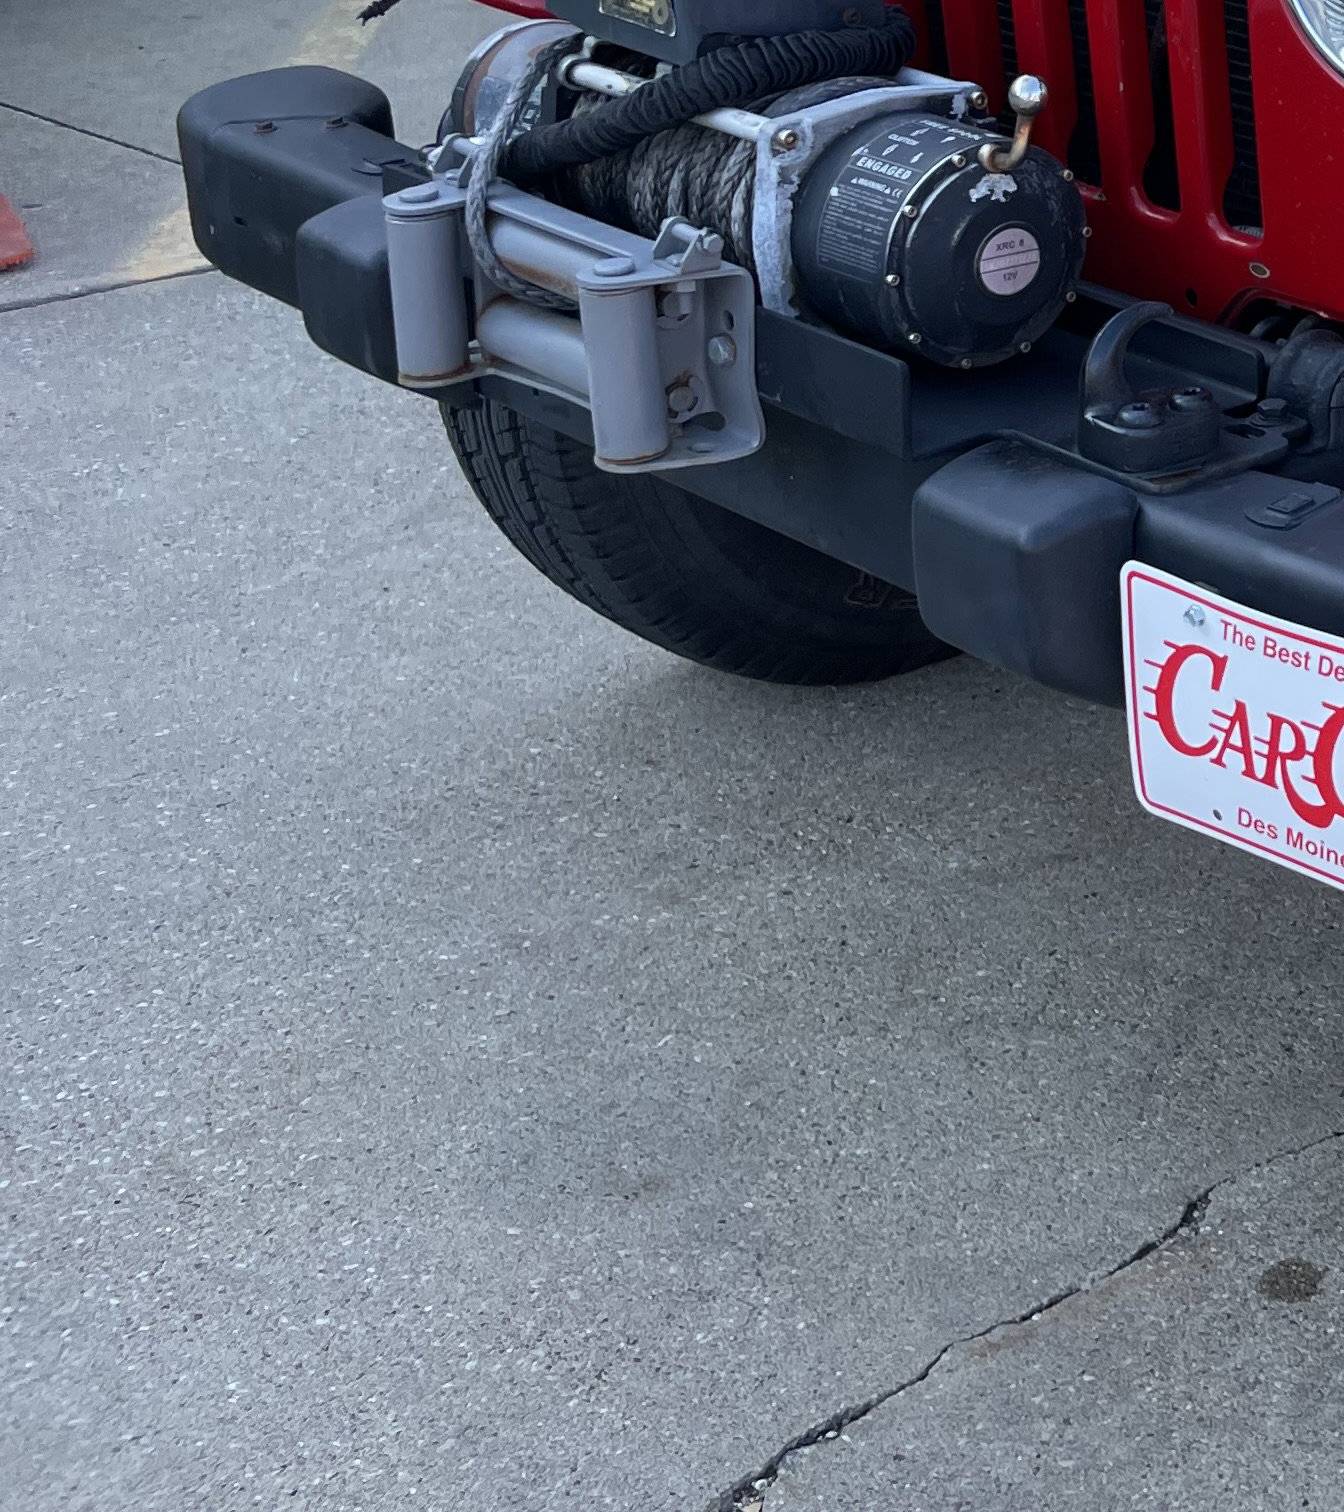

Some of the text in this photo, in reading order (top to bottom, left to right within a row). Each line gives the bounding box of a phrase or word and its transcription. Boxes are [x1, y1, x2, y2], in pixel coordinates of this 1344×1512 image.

[856, 156, 912, 179] ENGAGED
[996, 240, 1015, 251] XRC
[1003, 271, 1018, 281] 12V
[1220, 618, 1255, 651] The
[1263, 637, 1311, 670] Best
[1237, 807, 1279, 840] Des
